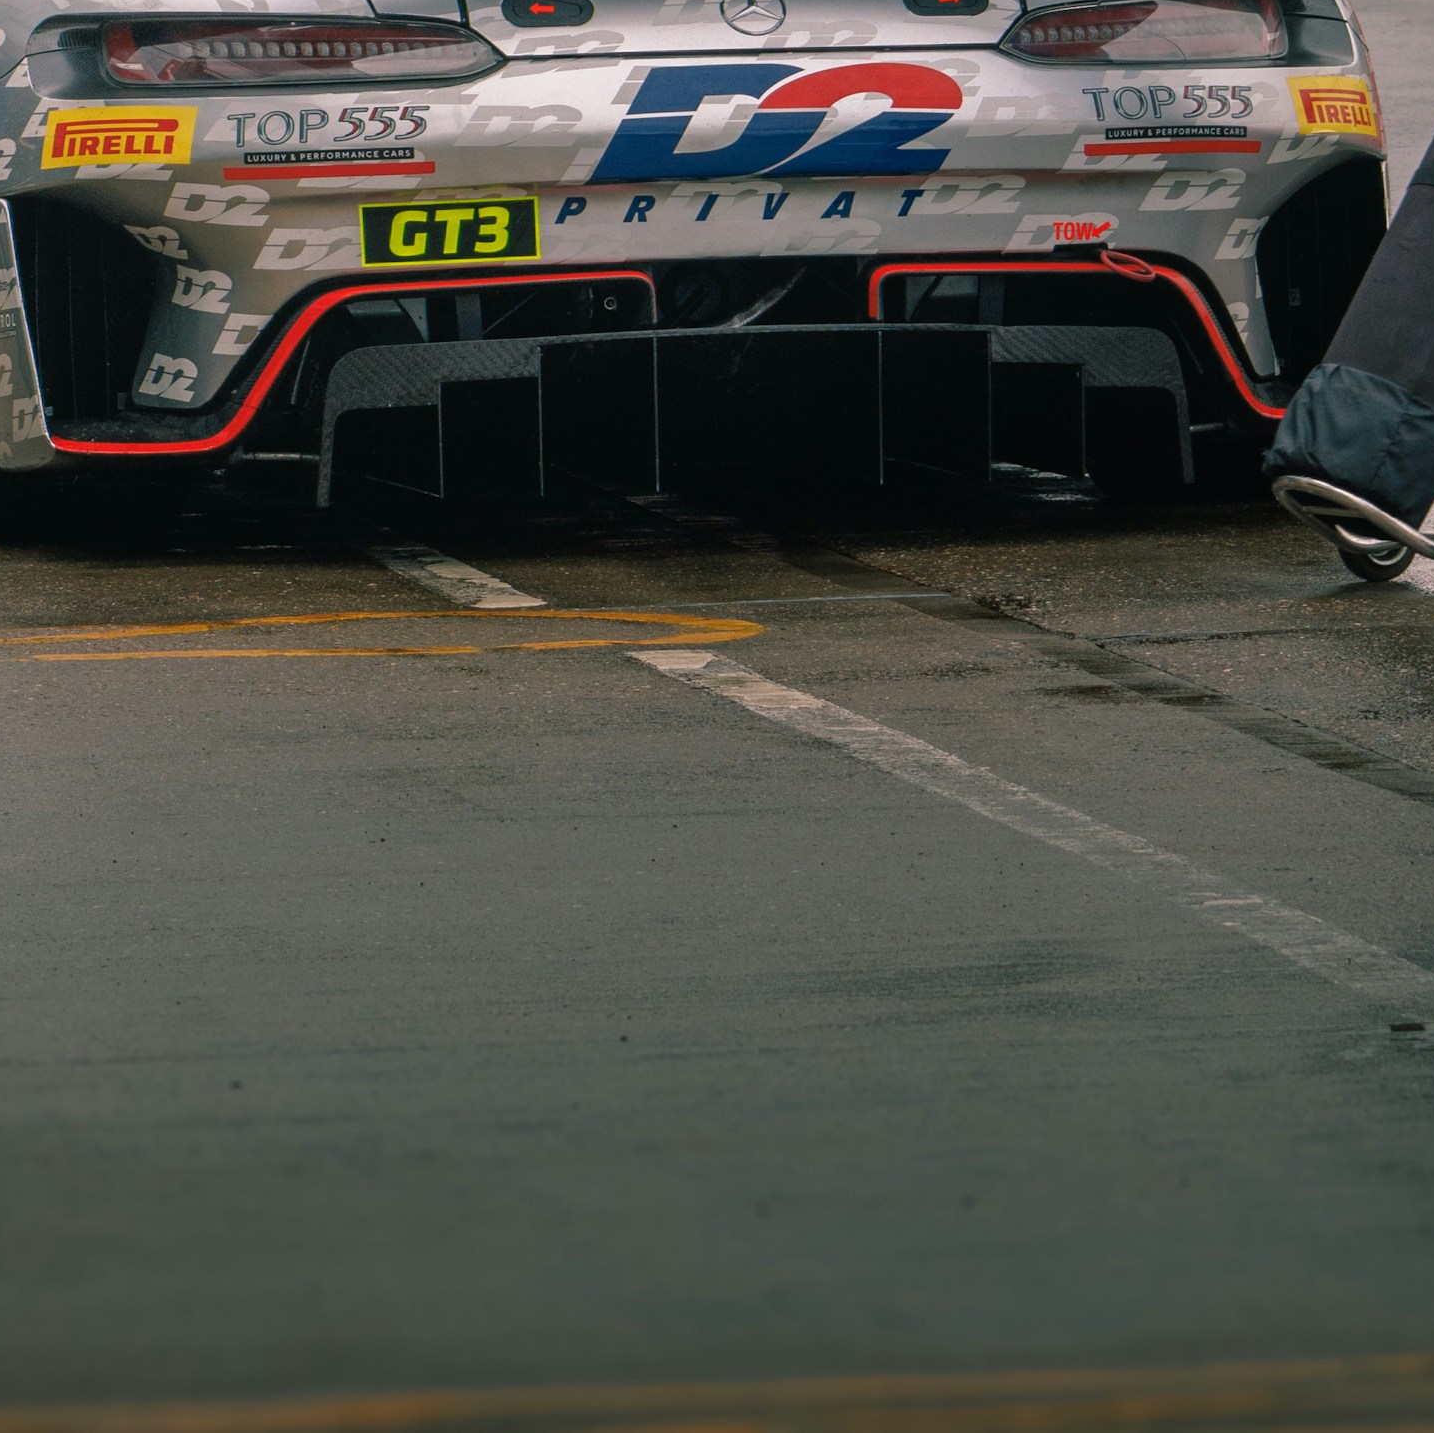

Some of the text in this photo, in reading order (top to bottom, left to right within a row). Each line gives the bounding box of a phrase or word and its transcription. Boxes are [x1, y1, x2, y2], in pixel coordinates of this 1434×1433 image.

[1082, 85, 1254, 121] TOP 555
[1299, 88, 1372, 127] PIRELLI
[51, 118, 179, 159] PIRELLI
[227, 106, 431, 148] TOP 555
[586, 63, 963, 186] D2
[1108, 129, 1145, 138] LUXURY
[1155, 127, 1221, 136] PERFORMANCE
[1223, 126, 1246, 135] CARS
[247, 153, 287, 163] LUXURY
[299, 150, 380, 161] PERFORMANCE
[383, 149, 412, 158] CARS
[164, 182, 271, 227] D2
[554, 189, 927, 225] PRIVAT
[907, 174, 1027, 216] D2
[1137, 168, 1247, 211] D2
[388, 206, 511, 257] GT3
[1053, 221, 1094, 241] TOW
[171, 264, 233, 315] D2
[138, 352, 198, 403] D2
